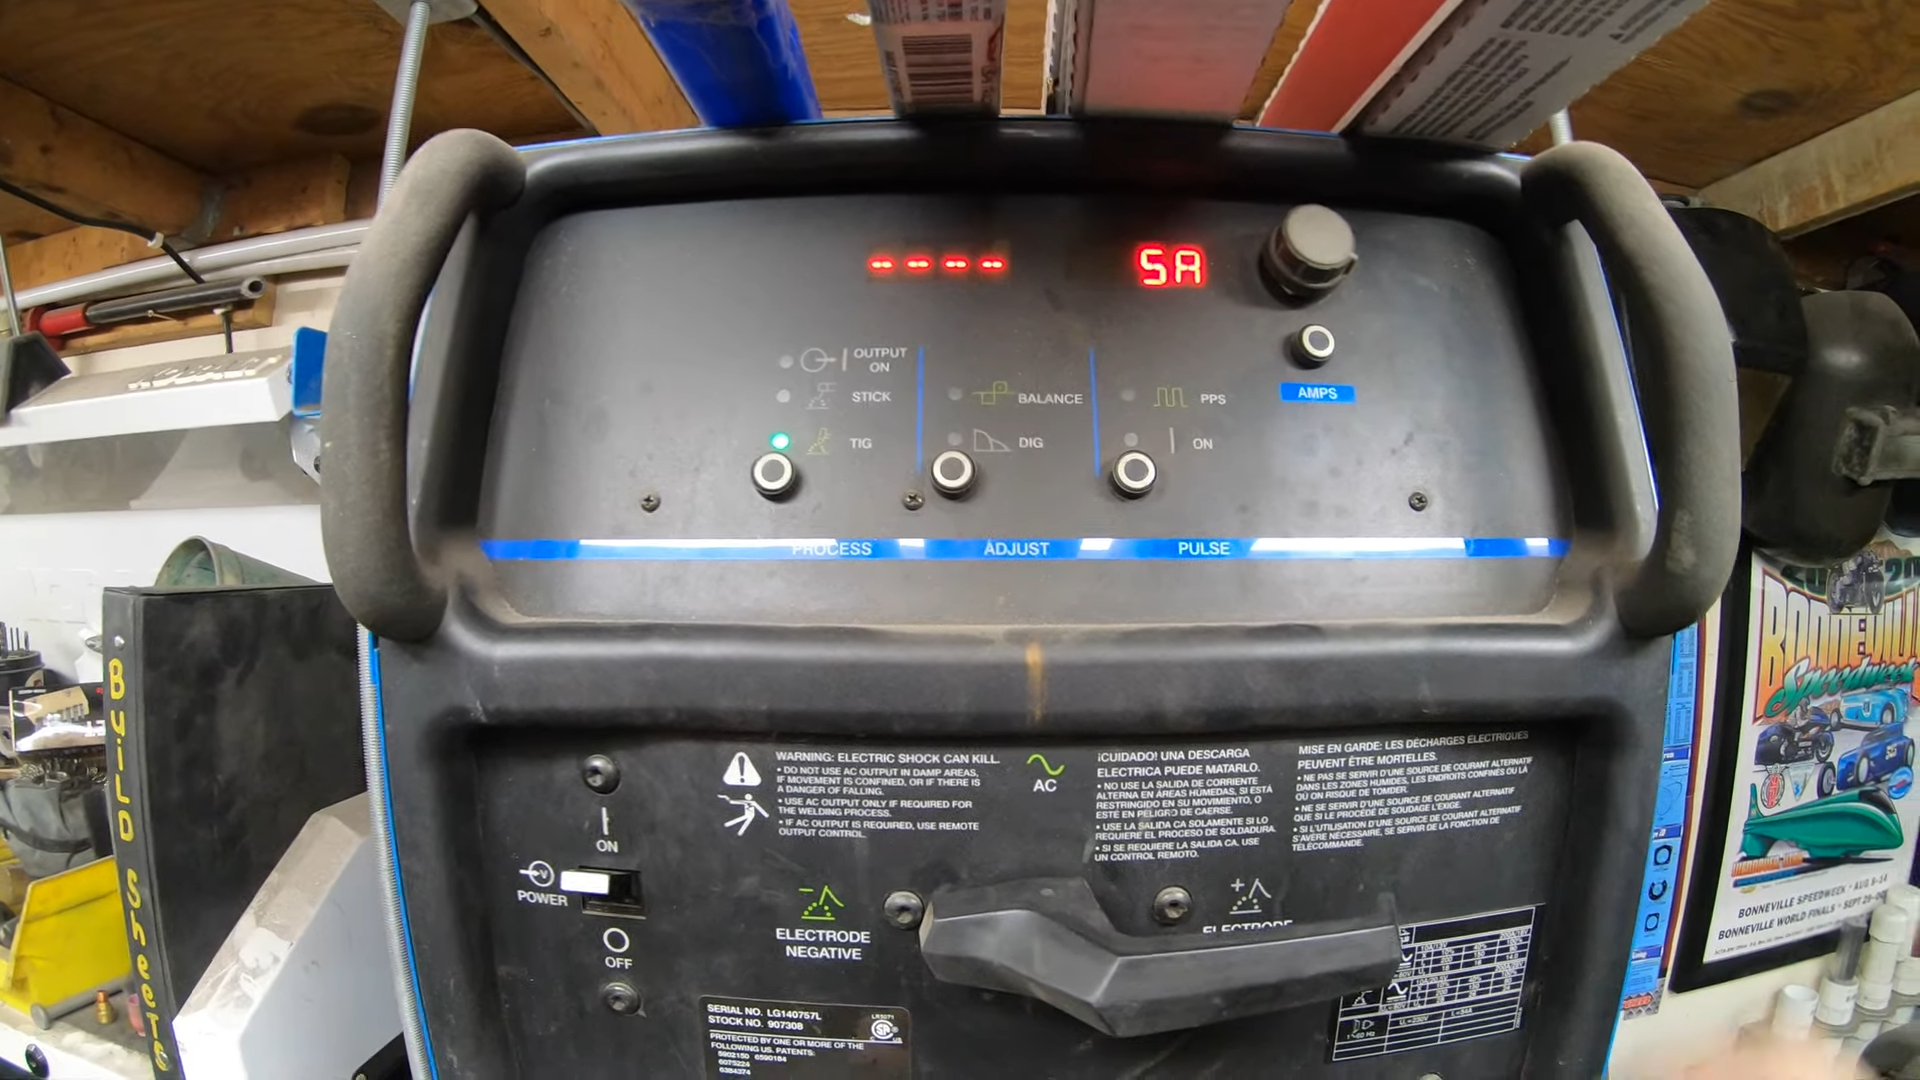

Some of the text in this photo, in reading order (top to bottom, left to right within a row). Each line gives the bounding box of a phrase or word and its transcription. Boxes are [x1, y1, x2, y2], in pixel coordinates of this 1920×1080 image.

[853, 347, 908, 359] OUTPUT
[869, 362, 890, 373] ON
[852, 391, 892, 402] STICK
[1018, 393, 1083, 404] BALANCE
[1200, 393, 1227, 405] PPS
[1298, 387, 1338, 400] AMPS
[849, 437, 873, 449] TIG
[1018, 437, 1044, 448] DIG
[1192, 438, 1213, 450] ON
[792, 541, 872, 556] PROCESS
[983, 542, 1050, 556] ADJUST
[1178, 541, 1230, 555] PULSE
[776, 751, 1000, 764] WARNING: ELECTRIC SHOCK CAN KILL.
[1160, 751, 1185, 761] UNA
[1187, 748, 1250, 760] DESCARGA
[784, 766, 797, 775] DO
[799, 766, 819, 775] NOT
[821, 766, 841, 775] USE
[843, 767, 857, 776] AC
[859, 767, 898, 776] OUTPUT
[900, 768, 910, 777] IN
[912, 768, 941, 777] DAMP
[1164, 765, 1202, 776] PUEDE
[1205, 763, 1260, 774] MATARLO.
[777, 776, 785, 784] IF
[787, 776, 841, 785] MOVEMENT
[843, 776, 852, 785] IS
[908, 777, 923, 786] OR
[925, 778, 934, 786] IF
[936, 778, 968, 787] THERE
[970, 778, 980, 787] IS
[1032, 779, 1058, 793] AC
[1104, 777, 1258, 791] NO USE LA SALIDA DE CORRIENTE
[777, 785, 884, 796] A DANGER OF FALLING.
[785, 797, 972, 809] USE AC OUTPUT ONLY IF REQUIRED FOR
[1096, 799, 1160, 810] RESTRINGIDO
[1162, 799, 1175, 808] EN
[1177, 798, 1190, 807] SU
[1254, 795, 1262, 804] O
[779, 806, 892, 818] THE WELDING PROCESS.
[786, 818, 793, 827] IF
[795, 819, 809, 827] AC
[811, 819, 849, 828] OUTPUT
[851, 820, 861, 828] IS
[916, 821, 936, 830] USE
[938, 822, 979, 831] REMOTE
[1103, 816, 1268, 831] USE LA SALIDA CA SOLAMENTE SI LO
[779, 827, 816, 837] OUTPUT
[596, 839, 619, 853] ON
[1095, 853, 1108, 862] UN
[1110, 851, 1155, 861] CONTROL
[516, 889, 569, 907] POWER
[1737, 897, 1795, 919] BONNEVILLE
[1797, 885, 1847, 905] SPEEDWEEK
[1718, 918, 1775, 940] BONNEVILLE
[1776, 911, 1807, 927] WORLD
[1807, 905, 1836, 922] FINALS
[775, 928, 871, 944] ELECTRODE
[785, 945, 863, 961] NEGATIVE
[604, 955, 633, 970] OFF
[707, 1004, 742, 1015] SERIAL
[744, 1007, 763, 1016] NO.
[708, 1016, 743, 1026] STOCK
[745, 1018, 763, 1028] NO.
[710, 1033, 864, 1050] PROTECTED BY ONE OR MORE OF THE
[711, 1042, 759, 1052] FOLLOWING
